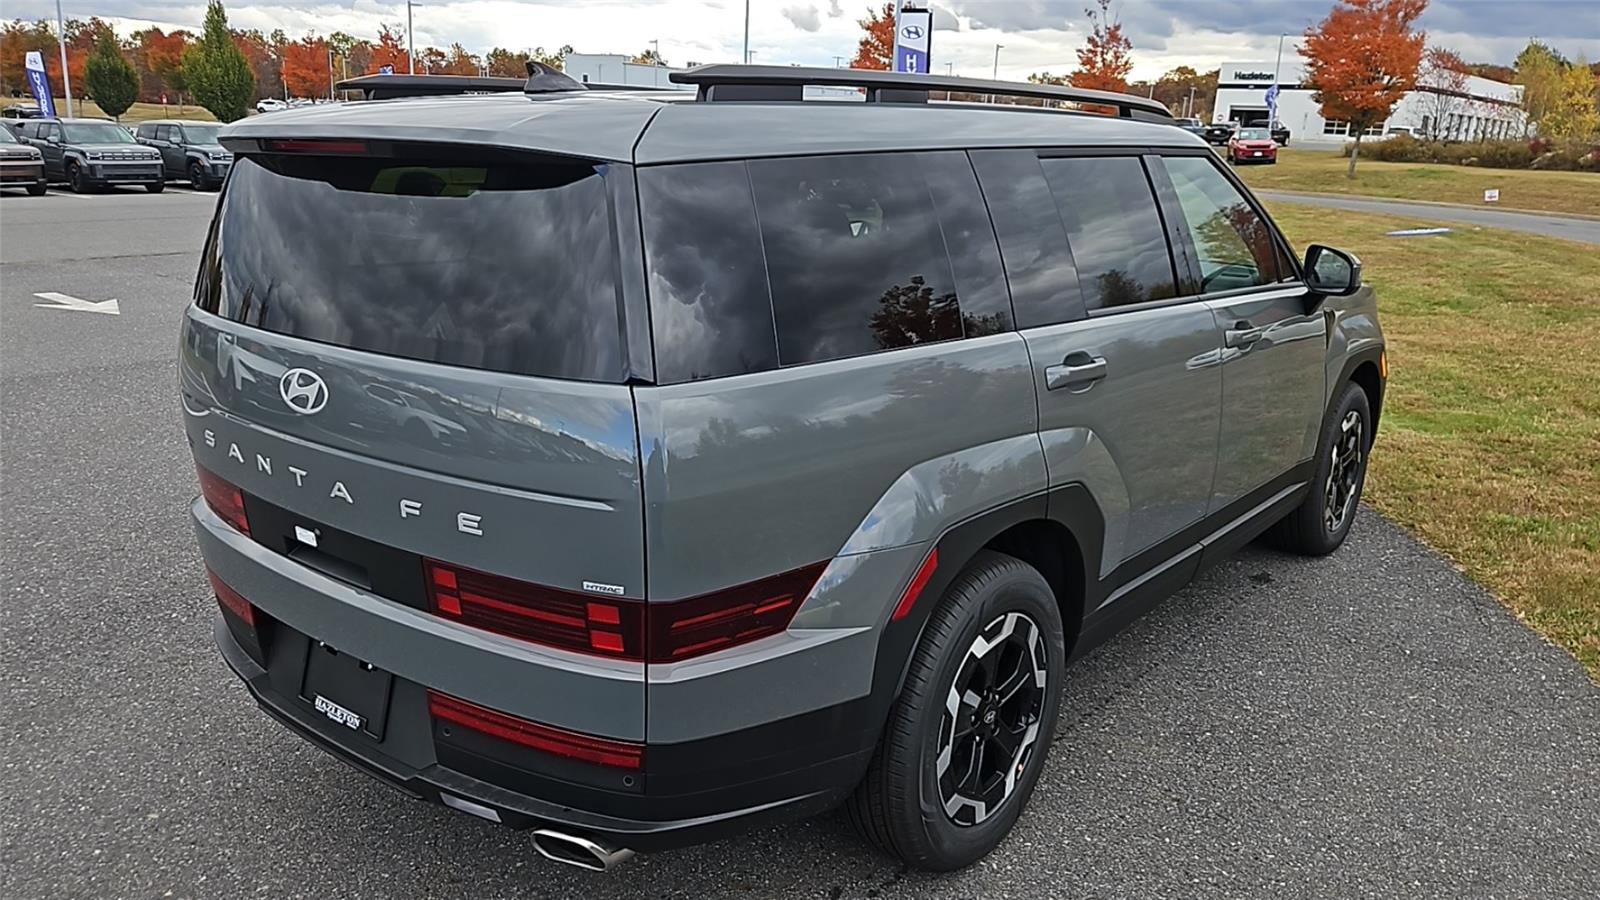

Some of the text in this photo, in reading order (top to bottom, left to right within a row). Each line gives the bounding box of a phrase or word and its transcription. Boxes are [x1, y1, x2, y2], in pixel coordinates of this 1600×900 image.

[1234, 71, 1275, 80] Hazleton
[204, 429, 483, 536] SANTA FE
[585, 583, 623, 593] HTRAC
[315, 697, 361, 727] HAZLETON
